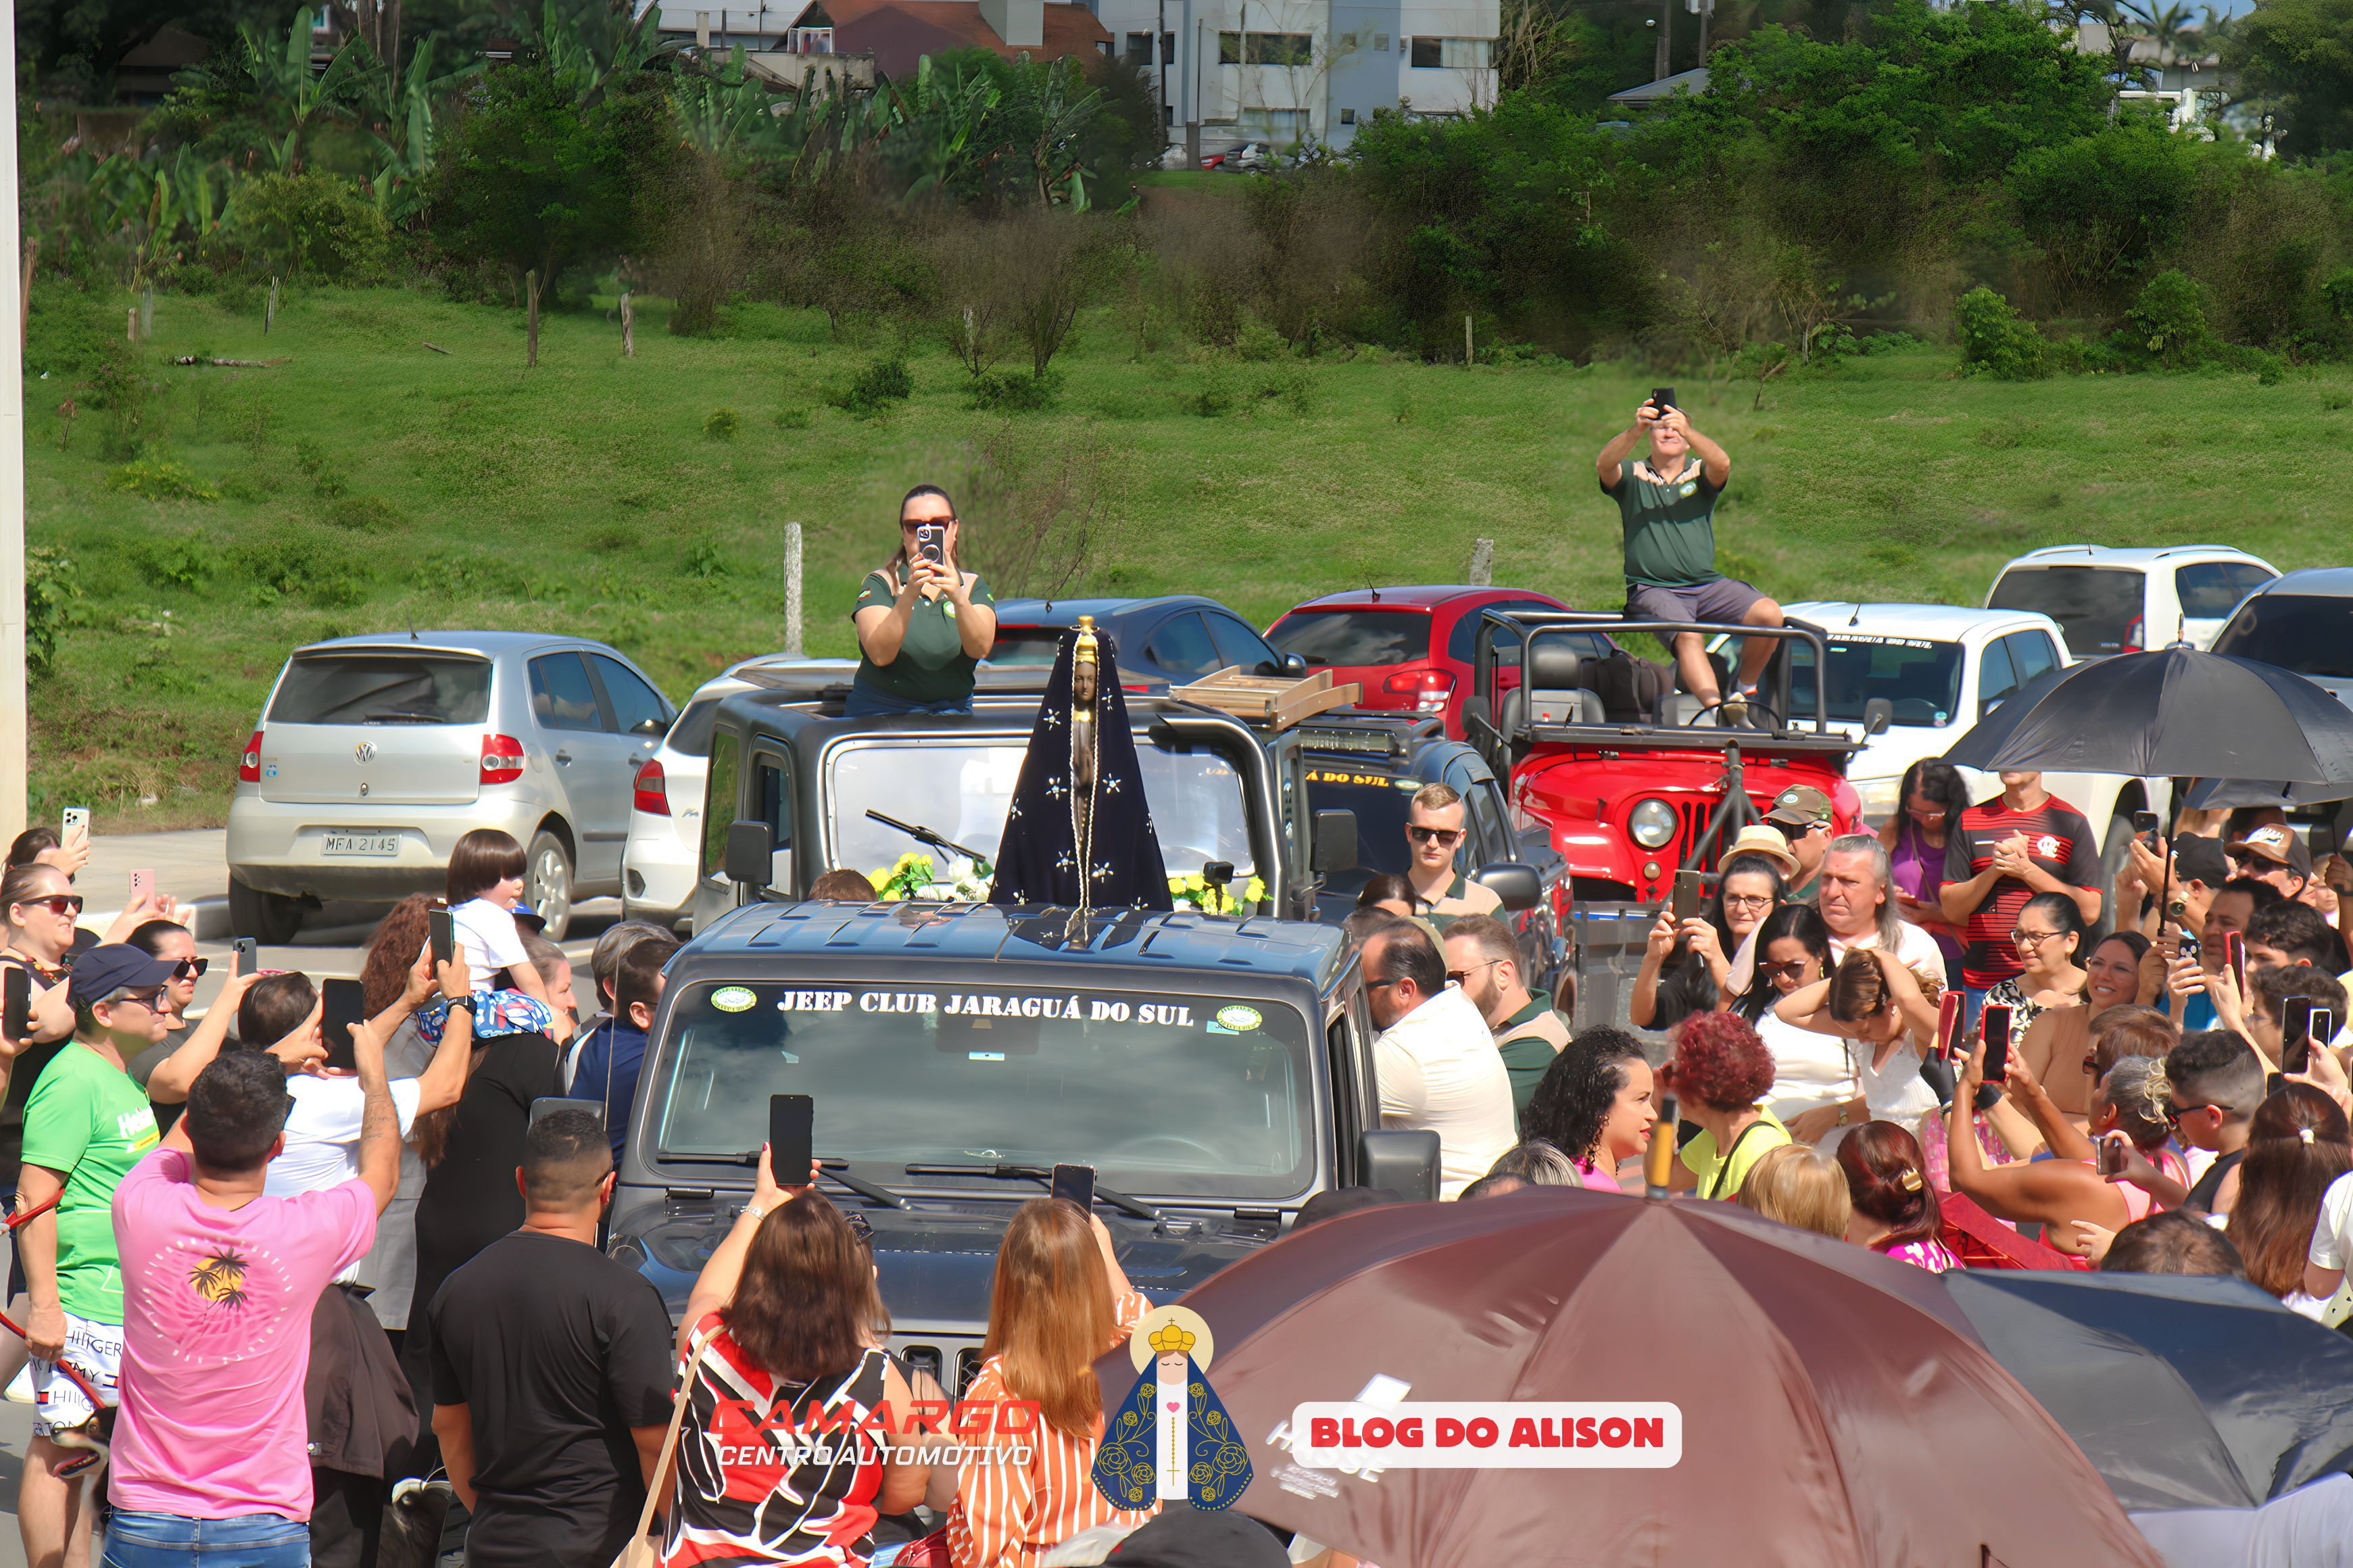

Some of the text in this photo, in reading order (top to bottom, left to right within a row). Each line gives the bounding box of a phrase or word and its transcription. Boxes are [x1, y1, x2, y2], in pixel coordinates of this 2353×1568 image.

[1322, 772, 1350, 783] DO
[1353, 775, 1389, 787] SUL
[777, 991, 853, 1012] JEEP
[859, 991, 938, 1013] CLUB
[944, 994, 1082, 1020] JARAGUÁ
[1090, 1001, 1130, 1022] DO
[1138, 1004, 1194, 1027] SUL
